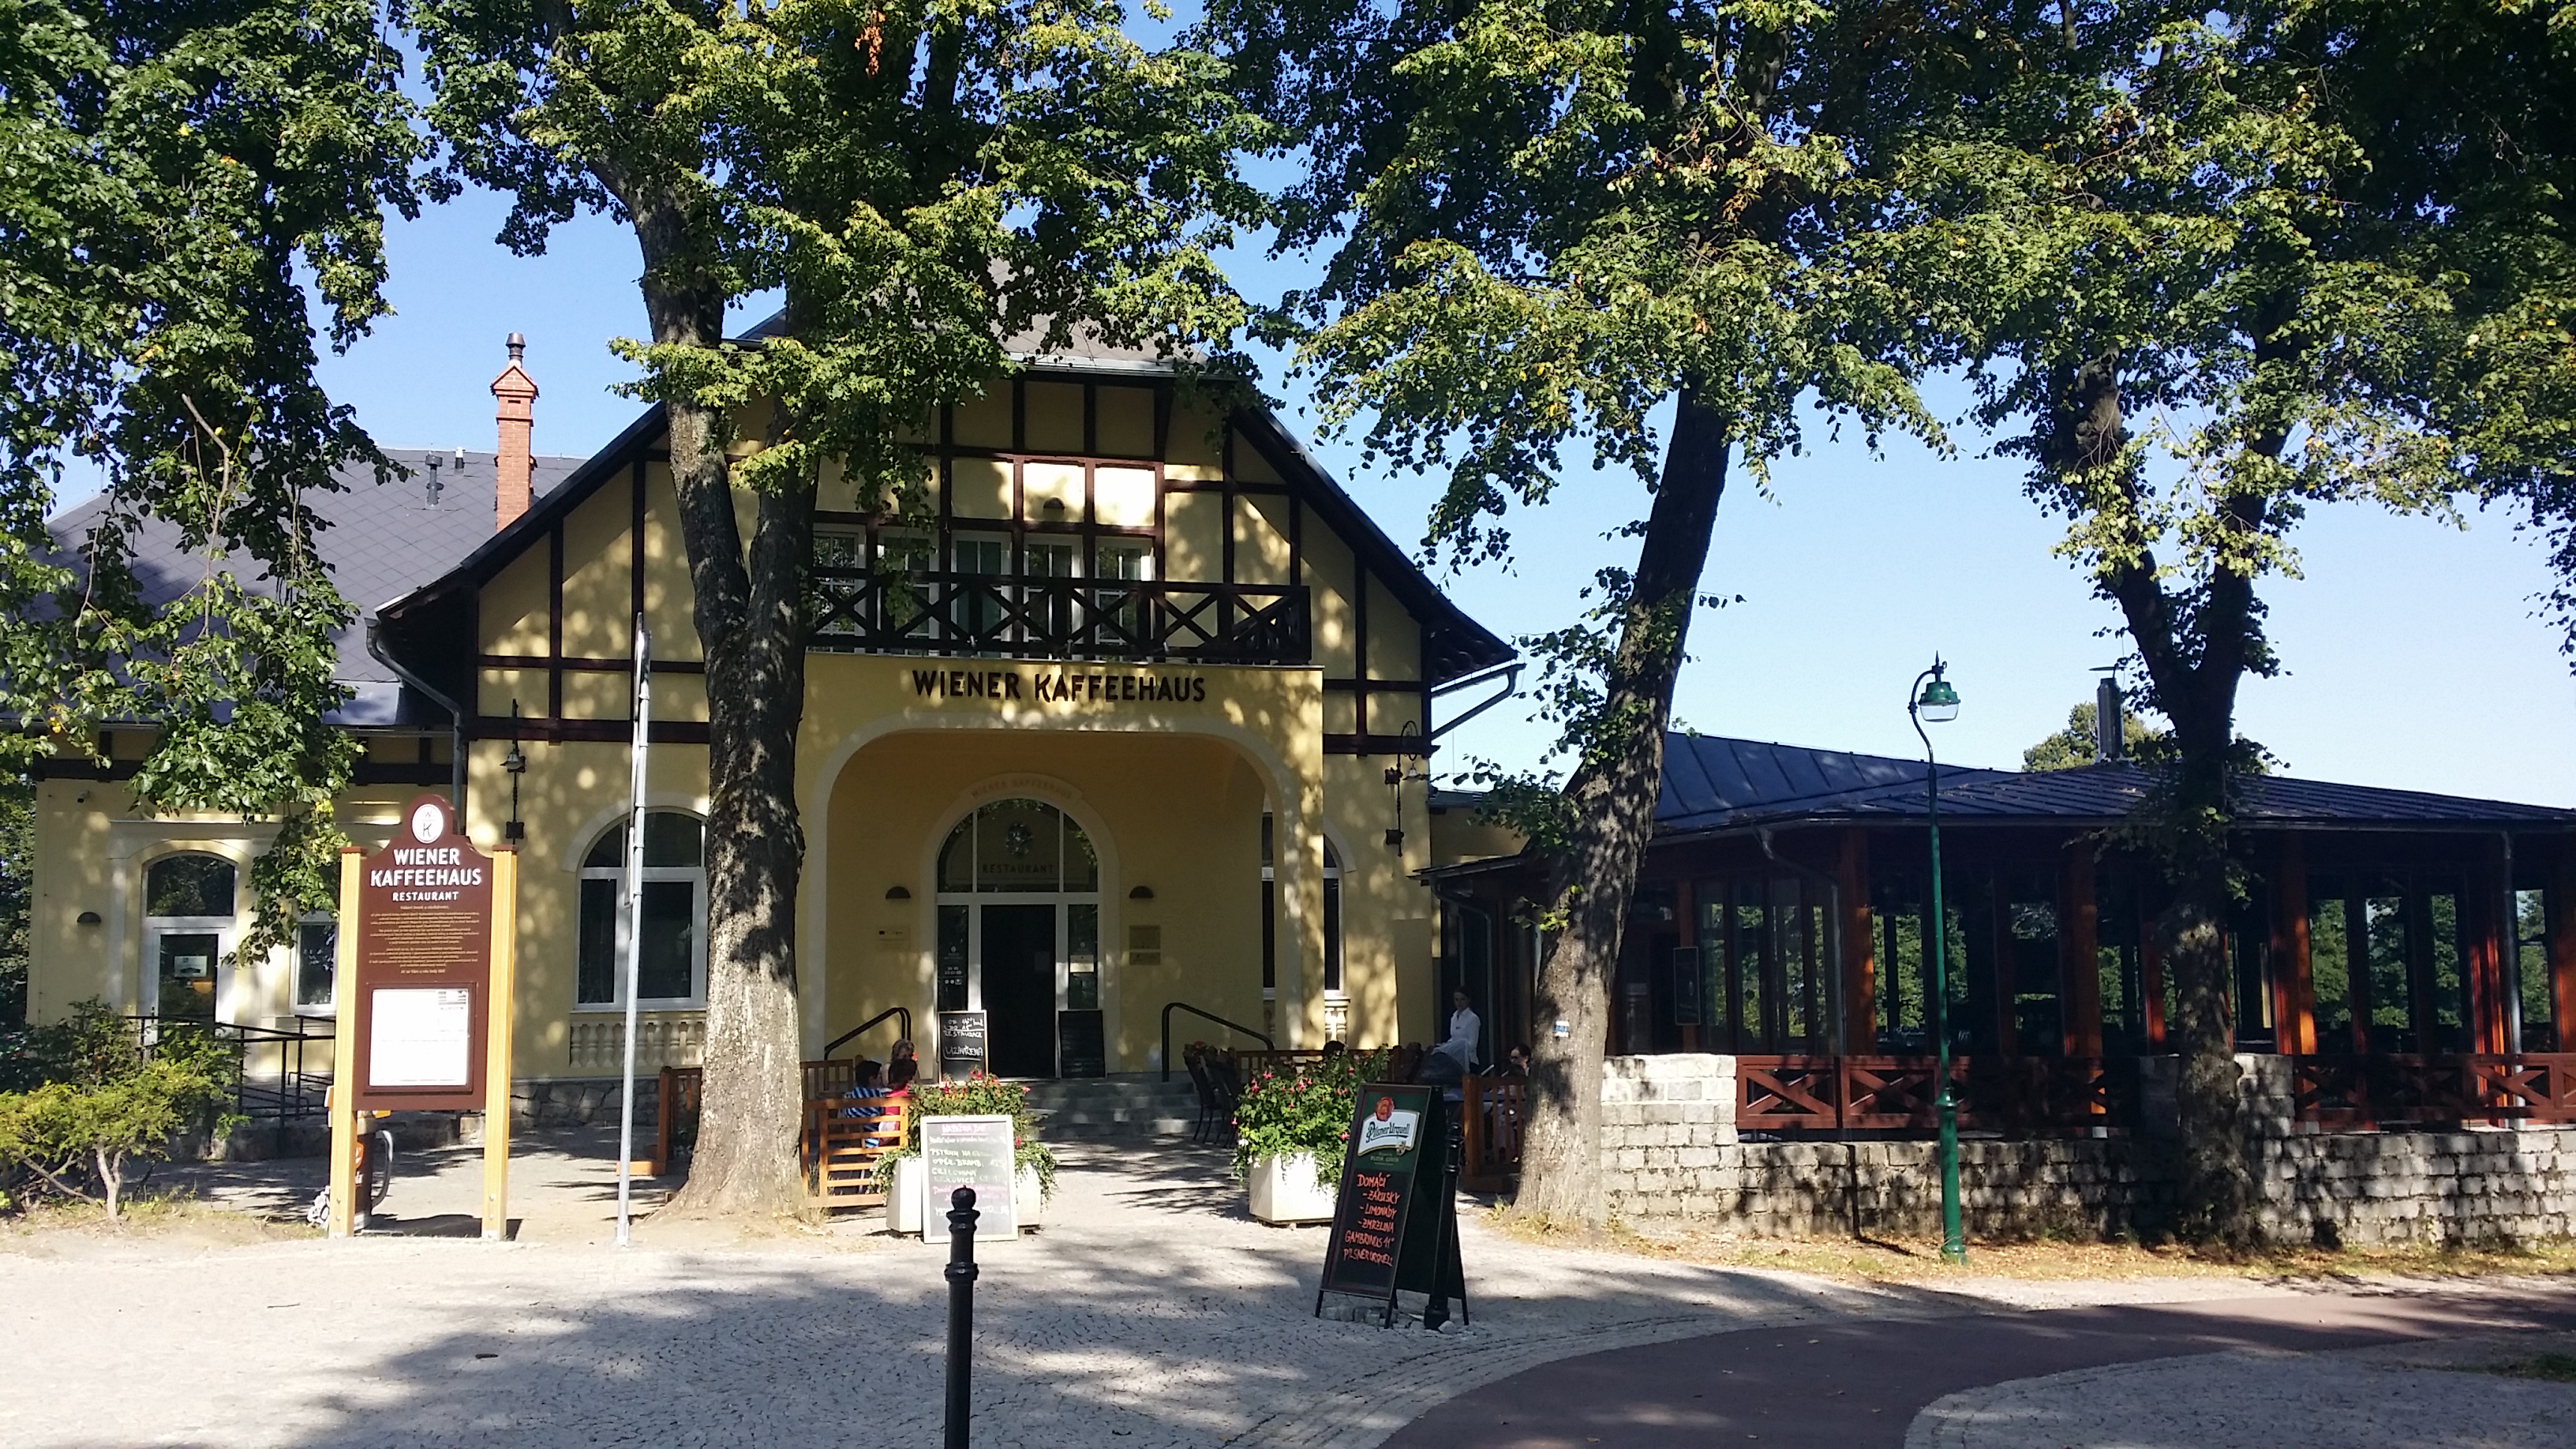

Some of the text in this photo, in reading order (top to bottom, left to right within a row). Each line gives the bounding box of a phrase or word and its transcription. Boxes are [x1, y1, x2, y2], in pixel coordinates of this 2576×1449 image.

[912, 669, 1206, 703] WIENER KAFFEEHAUS
[393, 847, 461, 867] WIENER
[370, 867, 481, 888] KAFFEEHAUS
[983, 863, 1054, 874] RESTAURANT
[392, 891, 459, 902] RESTAURANT
[1365, 1121, 1410, 1144] Pilsner Urquell
